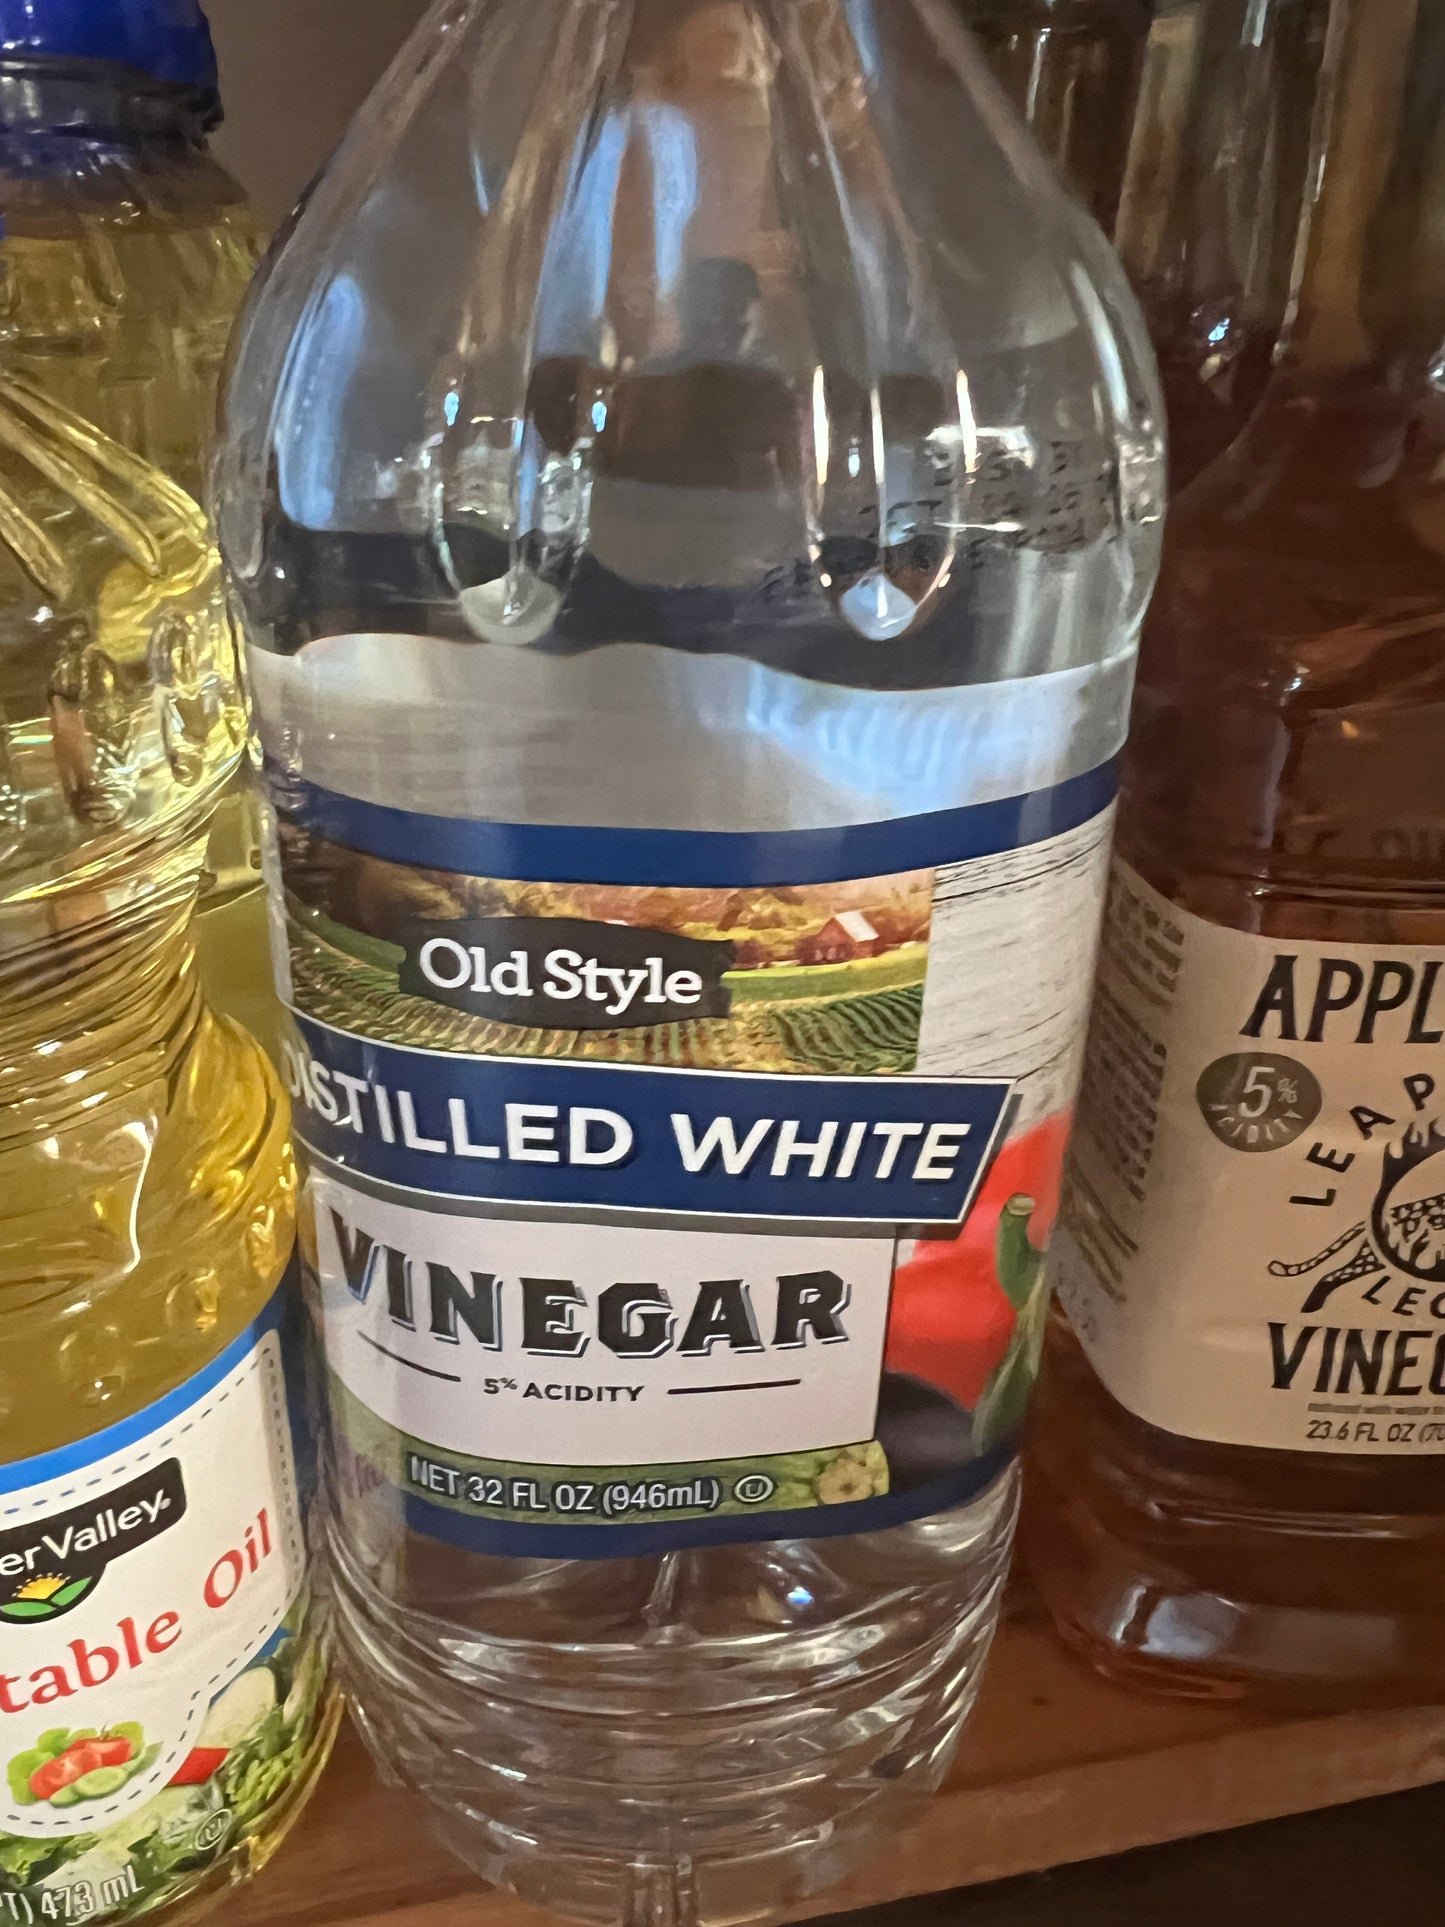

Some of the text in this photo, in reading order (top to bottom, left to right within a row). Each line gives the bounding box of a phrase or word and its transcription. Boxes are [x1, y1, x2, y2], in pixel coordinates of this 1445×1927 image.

[419, 937, 703, 1015] Old Style
[670, 1113, 971, 1181] WHITE
[329, 1205, 852, 1359] VINEGAR
[483, 1377, 645, 1402] 5% ACIDITY
[1354, 1421, 1380, 1442] FL
[1387, 1423, 1416, 1442] OZ
[410, 1455, 720, 1515] NET 32 FL OZ (946mL)
[42, 1489, 165, 1560] Valley
[203, 1507, 272, 1608] Oil
[0, 1864, 146, 1925] T) 473 mL
